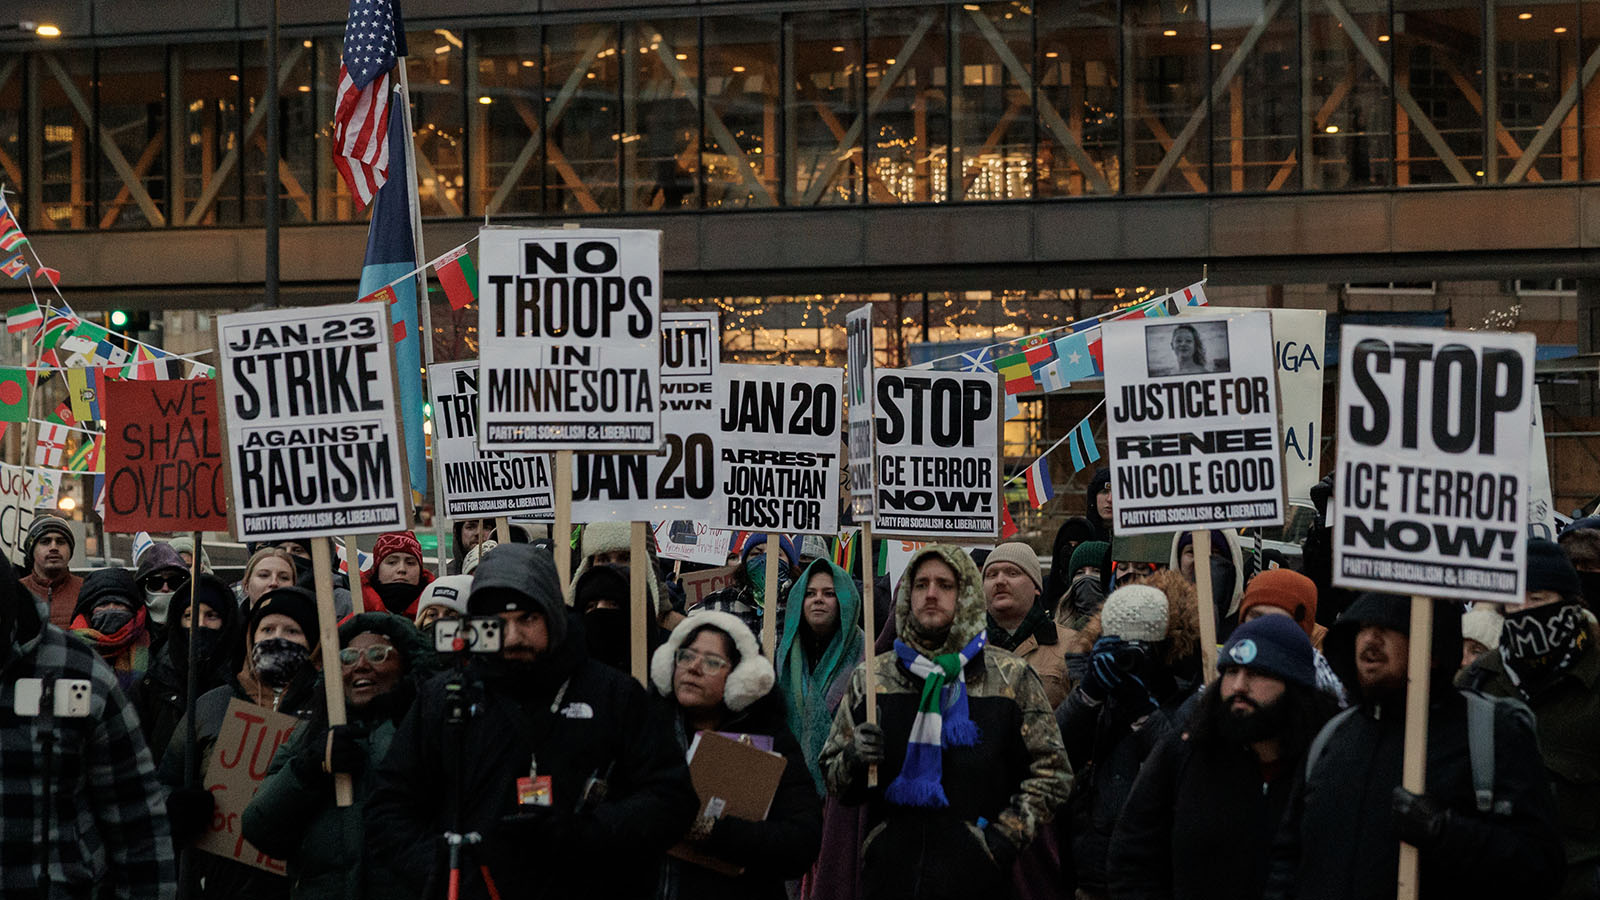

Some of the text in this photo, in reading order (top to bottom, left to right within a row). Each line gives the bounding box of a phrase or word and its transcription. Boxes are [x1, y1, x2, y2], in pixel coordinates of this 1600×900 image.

[525, 241, 618, 274] NO
[488, 275, 652, 338] TROOPS
[229, 317, 376, 351] JAN.23
[661, 327, 707, 368] UT!
[551, 346, 590, 366] IN
[233, 343, 384, 420] STRIKE
[488, 368, 653, 412] MINNESOTA
[1350, 339, 1523, 455] STOP
[152, 381, 207, 417] WE
[721, 380, 836, 436] JAN 20
[876, 375, 992, 447] STOP
[1114, 376, 1270, 422] JUSTICE FOR
[246, 424, 378, 448] AGAINST
[489, 425, 652, 441] PARTY FOR SOCIALISM & LIBERATION
[1116, 427, 1272, 460] RENEE
[238, 434, 393, 509] RACISM
[572, 433, 714, 500] JAN 20
[721, 448, 836, 467] ARREST
[878, 455, 906, 486] CE
[910, 456, 991, 488] TERROR
[445, 456, 548, 494] MINNESOTA
[724, 466, 826, 499] JONATHAN
[1118, 457, 1274, 500] NICOLE GOOD
[451, 495, 549, 513] PARTY FOR SOCIALISM & LIBERATION
[879, 489, 992, 512] NOW!
[1345, 462, 1517, 523] ICE TERROR
[246, 507, 397, 532] PARTY FOR SOCIALISM & LIBERATION
[728, 497, 780, 528] ROSS
[783, 500, 820, 529] FOR
[897, 516, 909, 527] FOR
[910, 517, 944, 529] SOCIALISM
[945, 518, 954, 529] &
[954, 519, 992, 530] LIBERATION
[1122, 502, 1275, 525] PARTY FOR SOCIALISM & LIBERATION
[1344, 516, 1517, 562] NOW!
[1445, 567, 1457, 586] &
